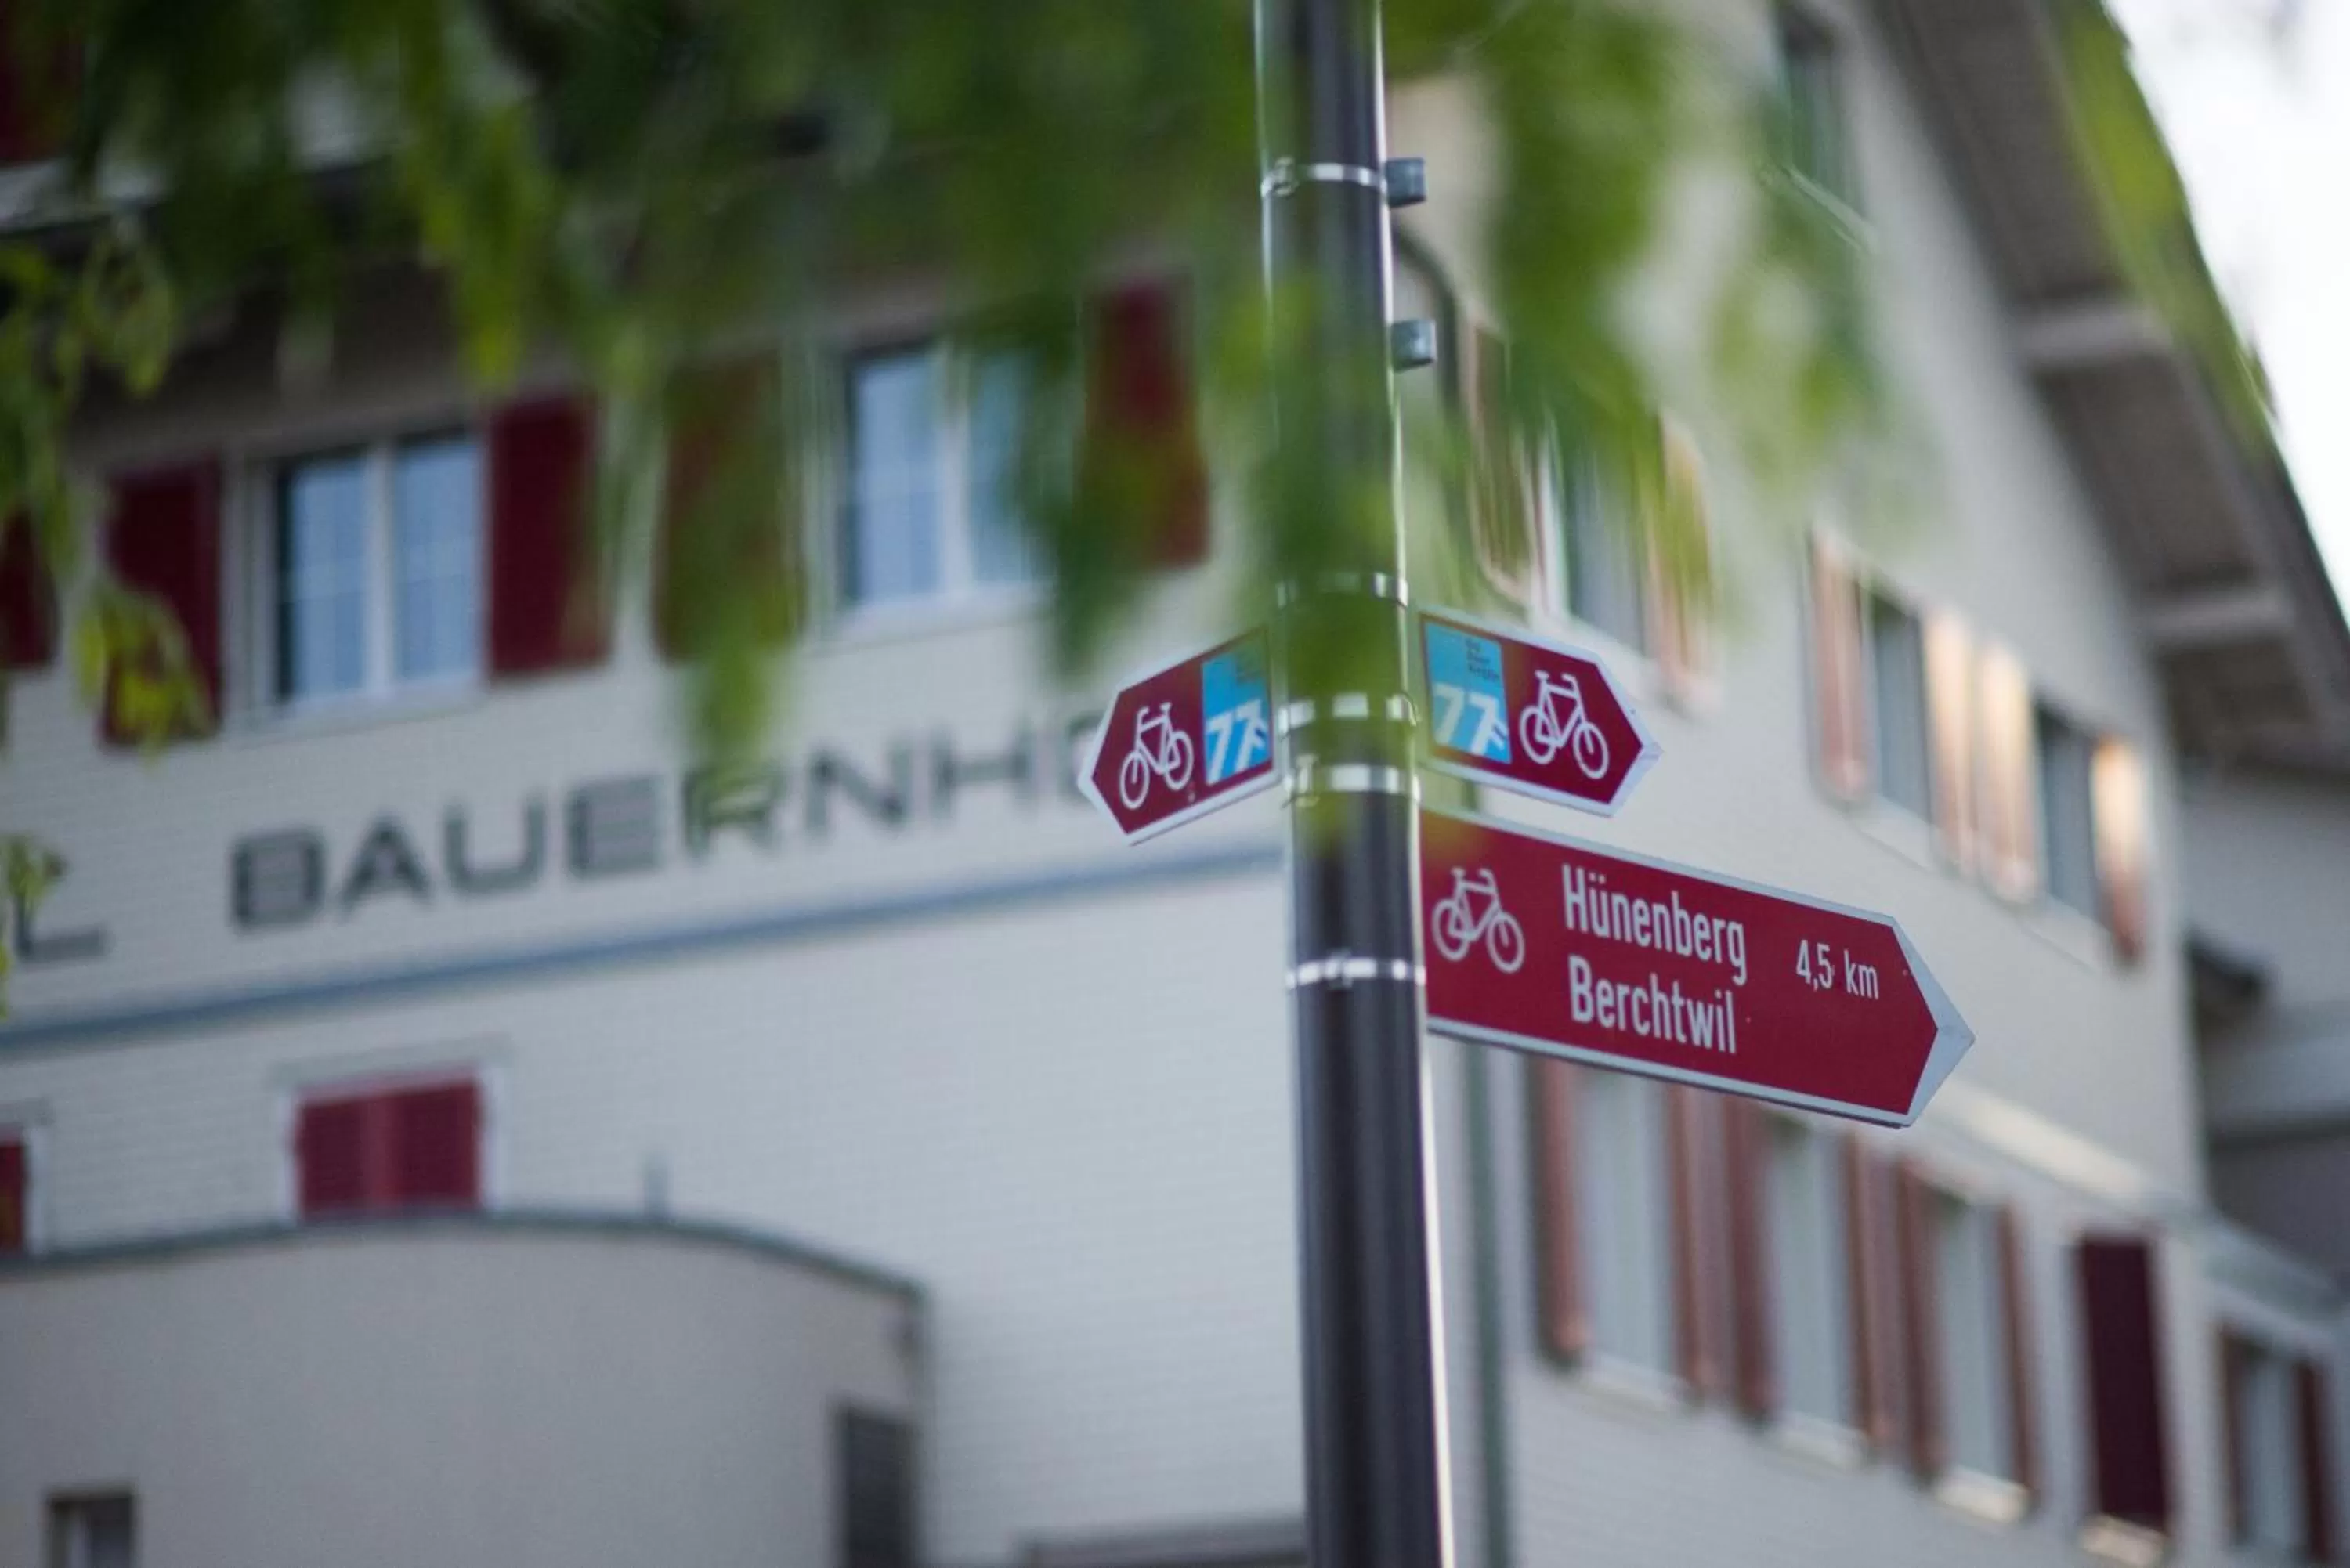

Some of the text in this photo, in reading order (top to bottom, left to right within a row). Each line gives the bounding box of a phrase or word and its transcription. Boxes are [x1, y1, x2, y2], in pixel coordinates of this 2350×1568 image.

[1205, 699, 1263, 786] 77
[1434, 682, 1499, 756] 77
[1562, 862, 1748, 987] Hünenberg
[1568, 952, 1737, 1054] Berchtwil
[1795, 938, 1879, 1001] 4,5 km
